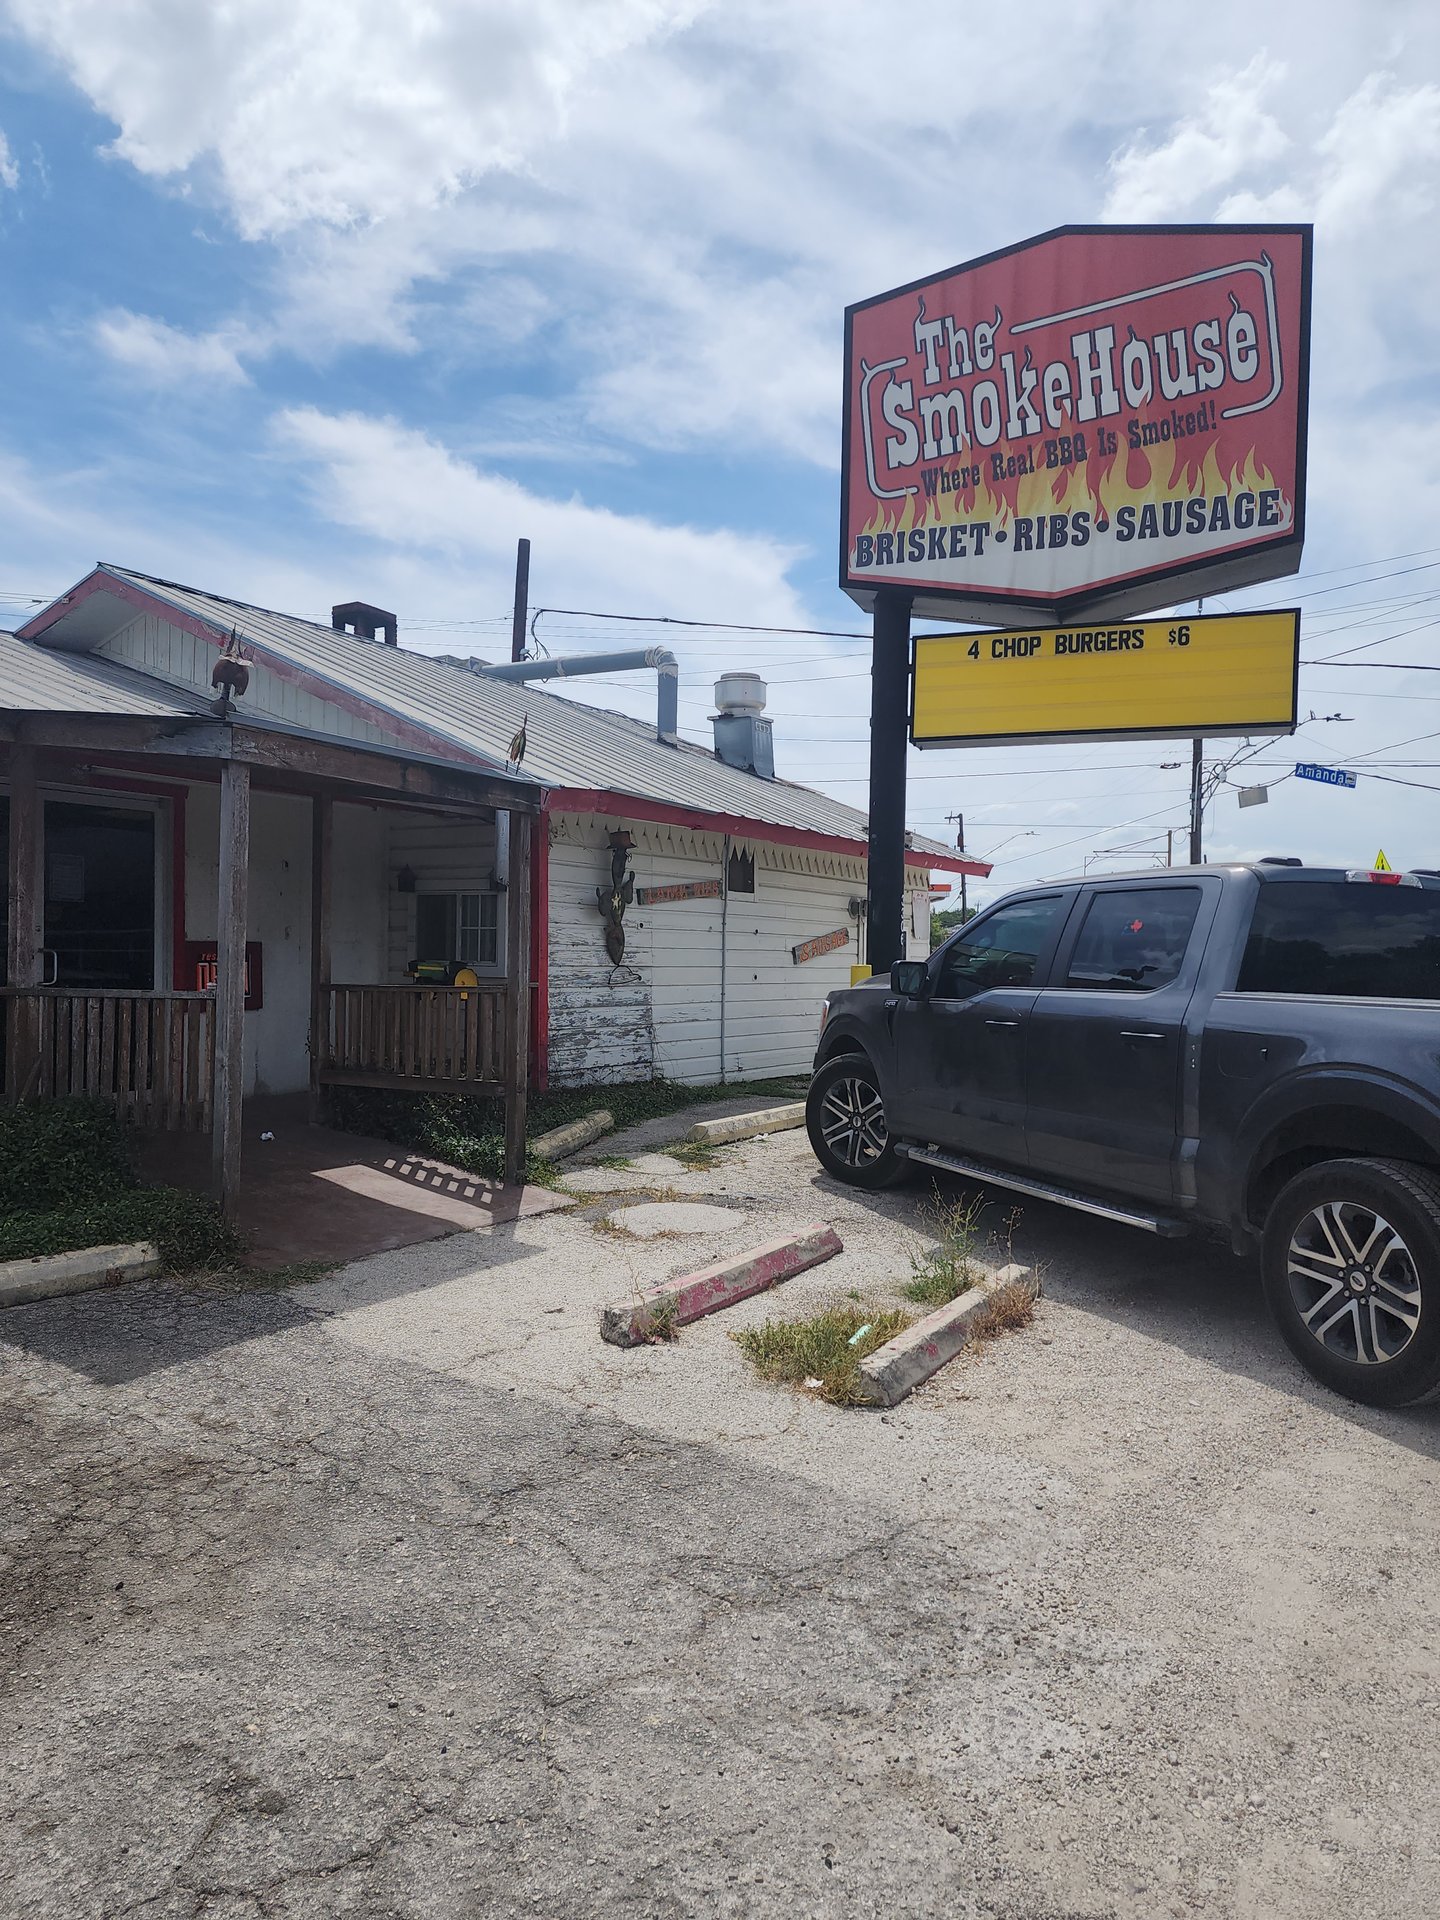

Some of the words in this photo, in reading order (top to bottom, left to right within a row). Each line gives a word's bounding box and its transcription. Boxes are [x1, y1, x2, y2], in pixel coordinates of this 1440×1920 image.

[881, 292, 1260, 470] SmokeHouse
[914, 297, 1003, 386] The
[921, 463, 981, 498] Where
[990, 444, 1035, 482] Real
[1044, 432, 1088, 470] BBQ
[1097, 426, 1118, 457] Is
[1127, 400, 1217, 449] Smoked!
[855, 521, 990, 568] BRISKET
[1013, 511, 1091, 552] RIBS
[1115, 489, 1281, 541] SAUSAGE
[967, 640, 980, 660] 4
[991, 635, 1042, 659] CHOP
[1054, 628, 1145, 655] BURGERS
[1168, 625, 1191, 647] $6
[1296, 764, 1345, 784] Amanda
